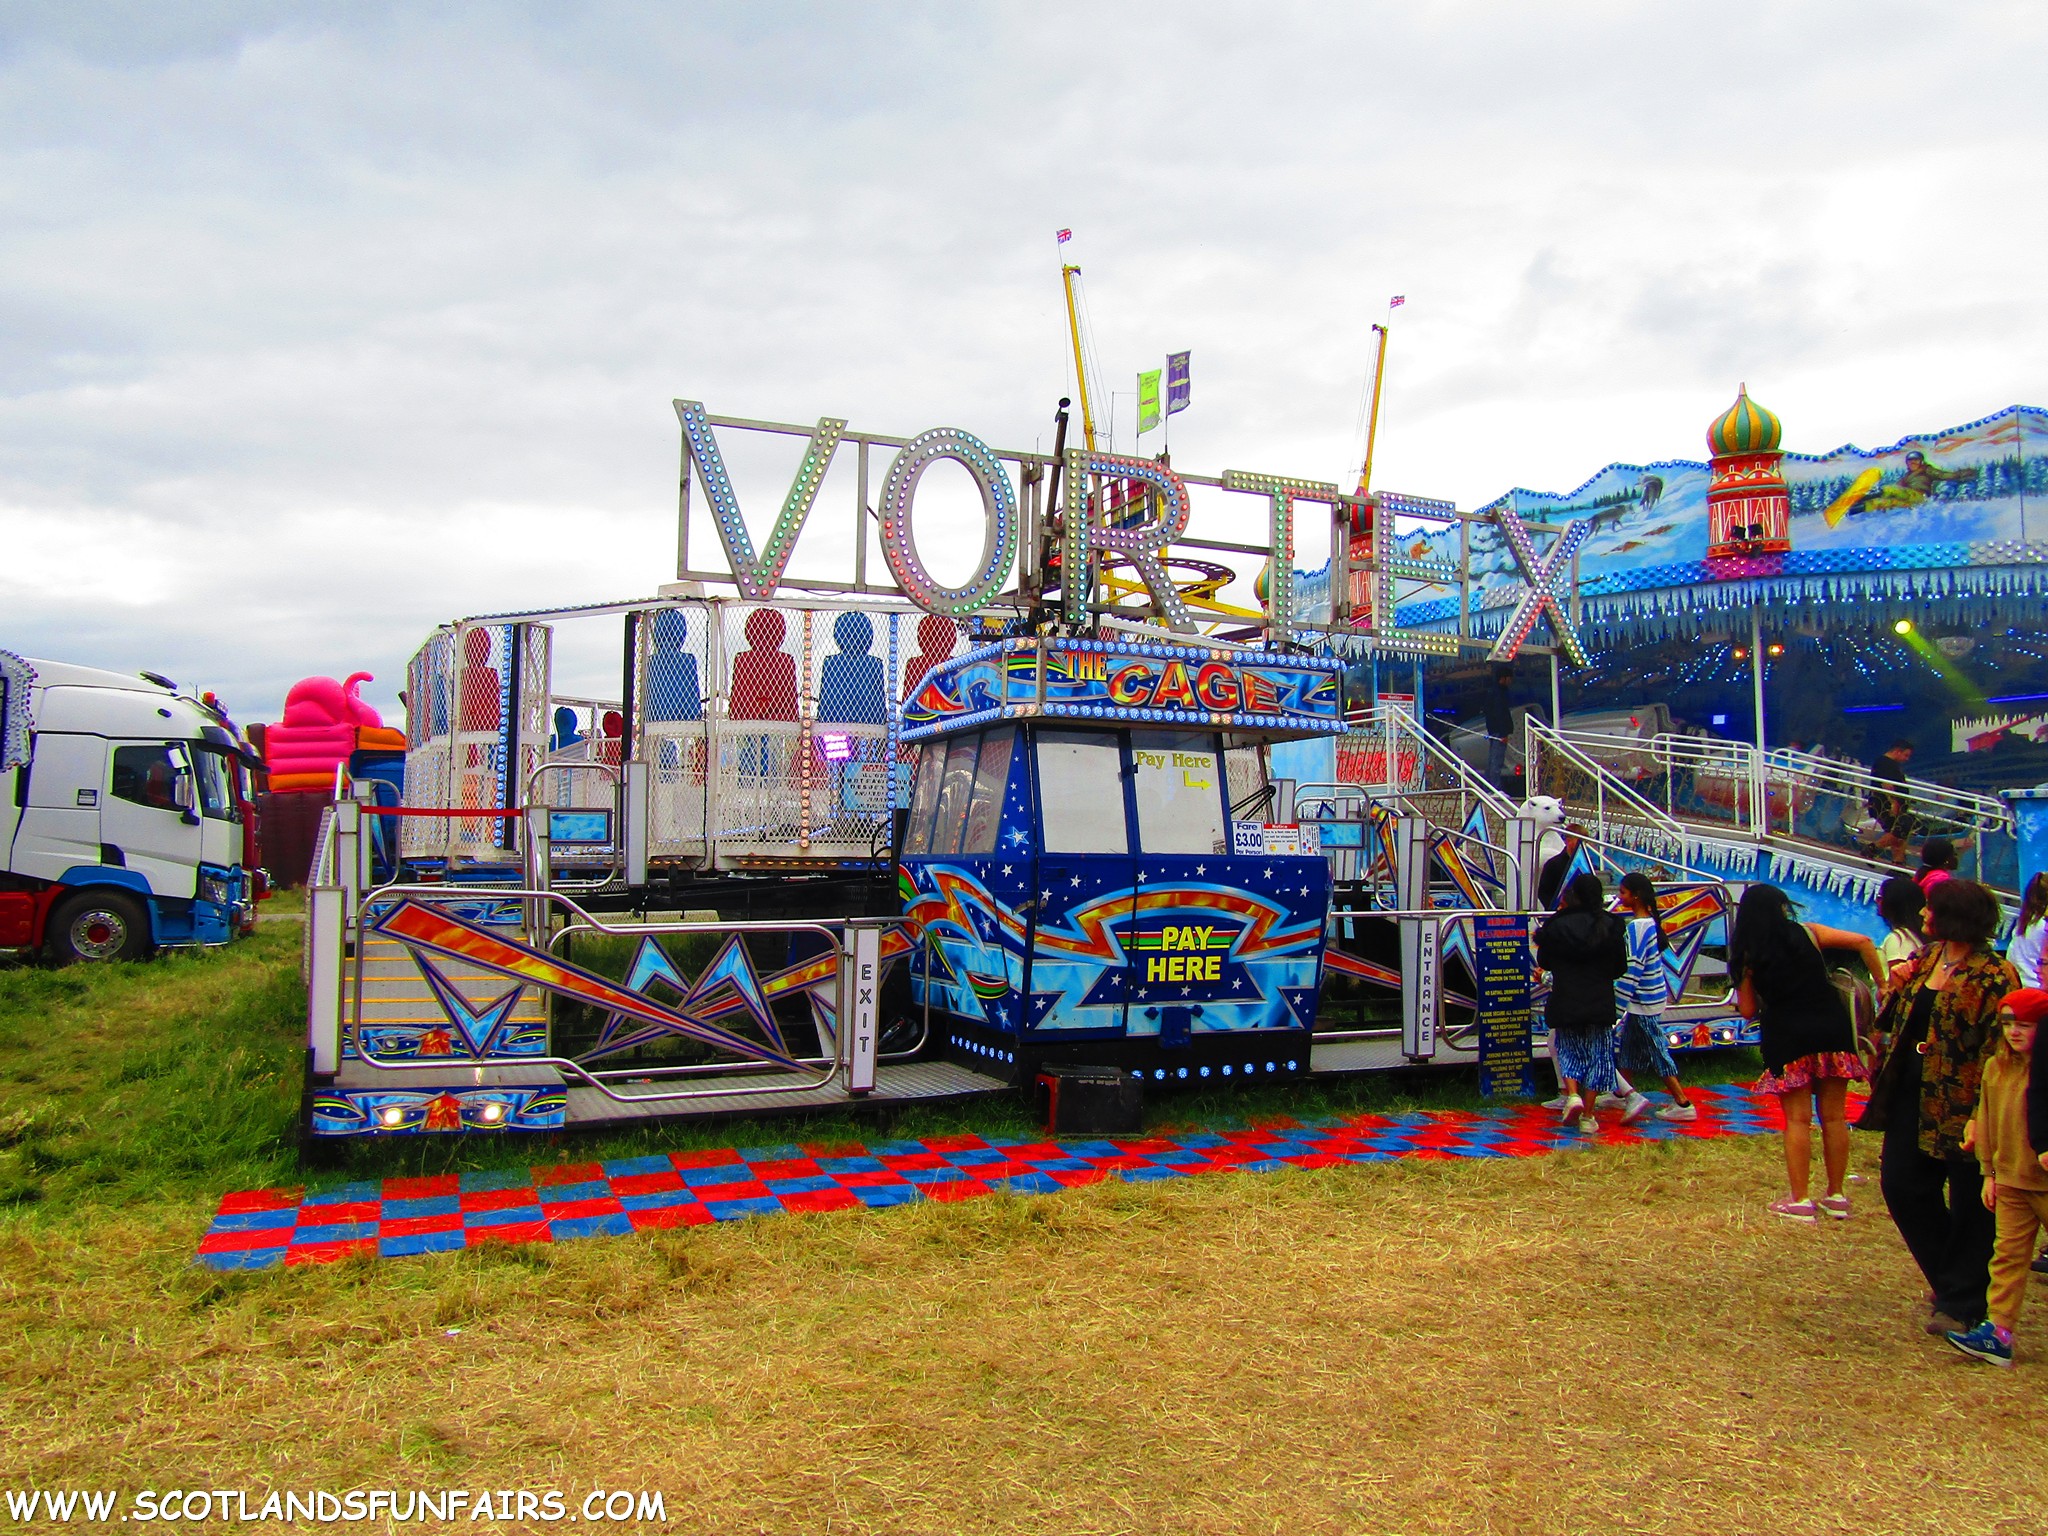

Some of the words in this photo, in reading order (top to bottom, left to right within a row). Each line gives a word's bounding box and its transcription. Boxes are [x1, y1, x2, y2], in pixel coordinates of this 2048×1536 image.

[673, 398, 1592, 668] VORTEX
[1062, 650, 1108, 681] THE
[1108, 659, 1281, 714] CAGE
[1136, 751, 1165, 769] Pay
[1172, 752, 1211, 768] Here
[1235, 833, 1262, 847] £3.00
[1162, 926, 1214, 951] PAY
[1147, 956, 1221, 982] HERE
[1421, 933, 1432, 1041] ENTRANCE
[859, 964, 872, 1053] EXIT
